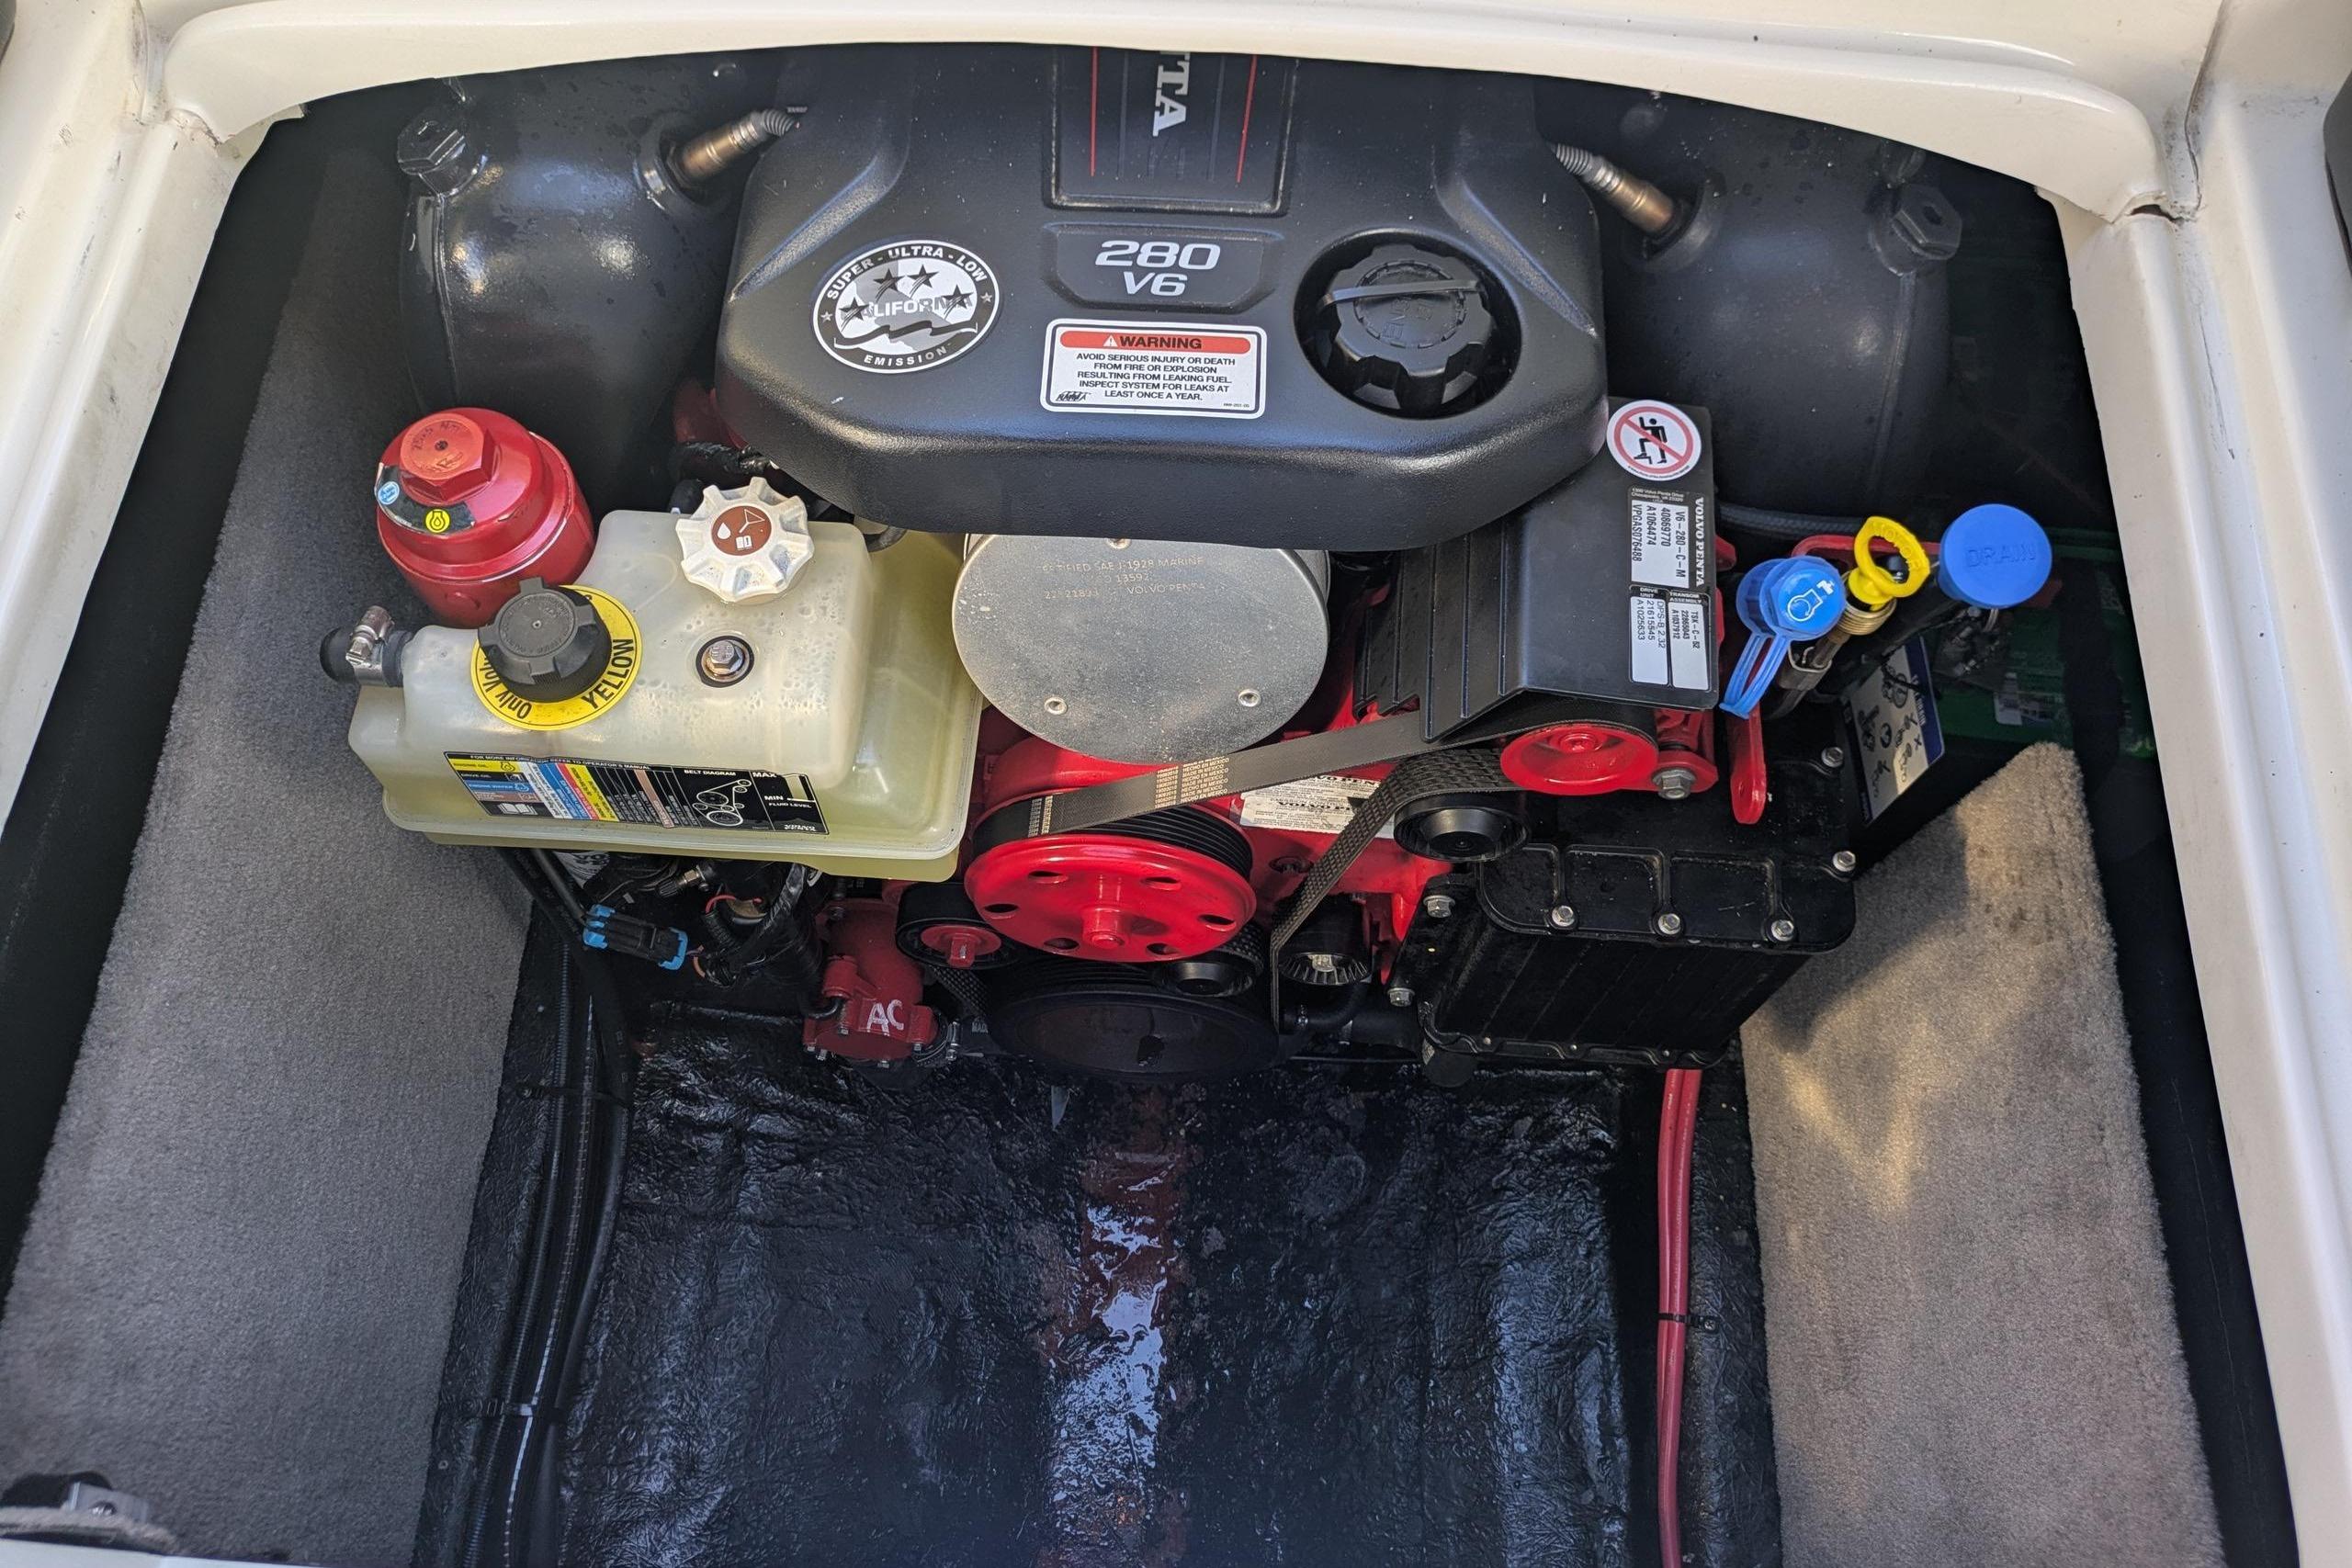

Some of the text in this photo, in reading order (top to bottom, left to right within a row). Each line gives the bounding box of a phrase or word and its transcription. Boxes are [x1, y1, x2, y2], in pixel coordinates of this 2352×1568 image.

[1153, 51, 1190, 137] TA
[1095, 241, 1221, 270] 280
[827, 245, 988, 300] SUPER ULTRA LOW
[1124, 271, 1188, 296] V6
[864, 345, 947, 367] EMISSION
[1120, 335, 1203, 350] WARNING
[1093, 362, 1122, 370] FROM
[1163, 365, 1217, 374] EXPLOSION
[1151, 355, 1186, 364] INJURY
[1204, 357, 1235, 366] DEATH
[1077, 371, 1131, 380] RESULTING
[1163, 374, 1204, 383] LEAKING
[1079, 381, 1119, 389] INSPECT
[1121, 382, 1160, 390] SYSTEM
[1184, 384, 1216, 392] LEAKS
[1104, 389, 1135, 398] LEAST
[1136, 390, 1165, 399] ONCE
[1646, 505, 1657, 546] A1064474
[1661, 507, 1671, 547] 40869770
[1695, 497, 1705, 587] VOLVO PENTA
[1637, 599, 1645, 641] A1025633
[1647, 600, 1655, 641] 21615545
[581, 638, 634, 710] YELLOW
[495, 690, 533, 720] Only
[867, 999, 905, 1037] AC
